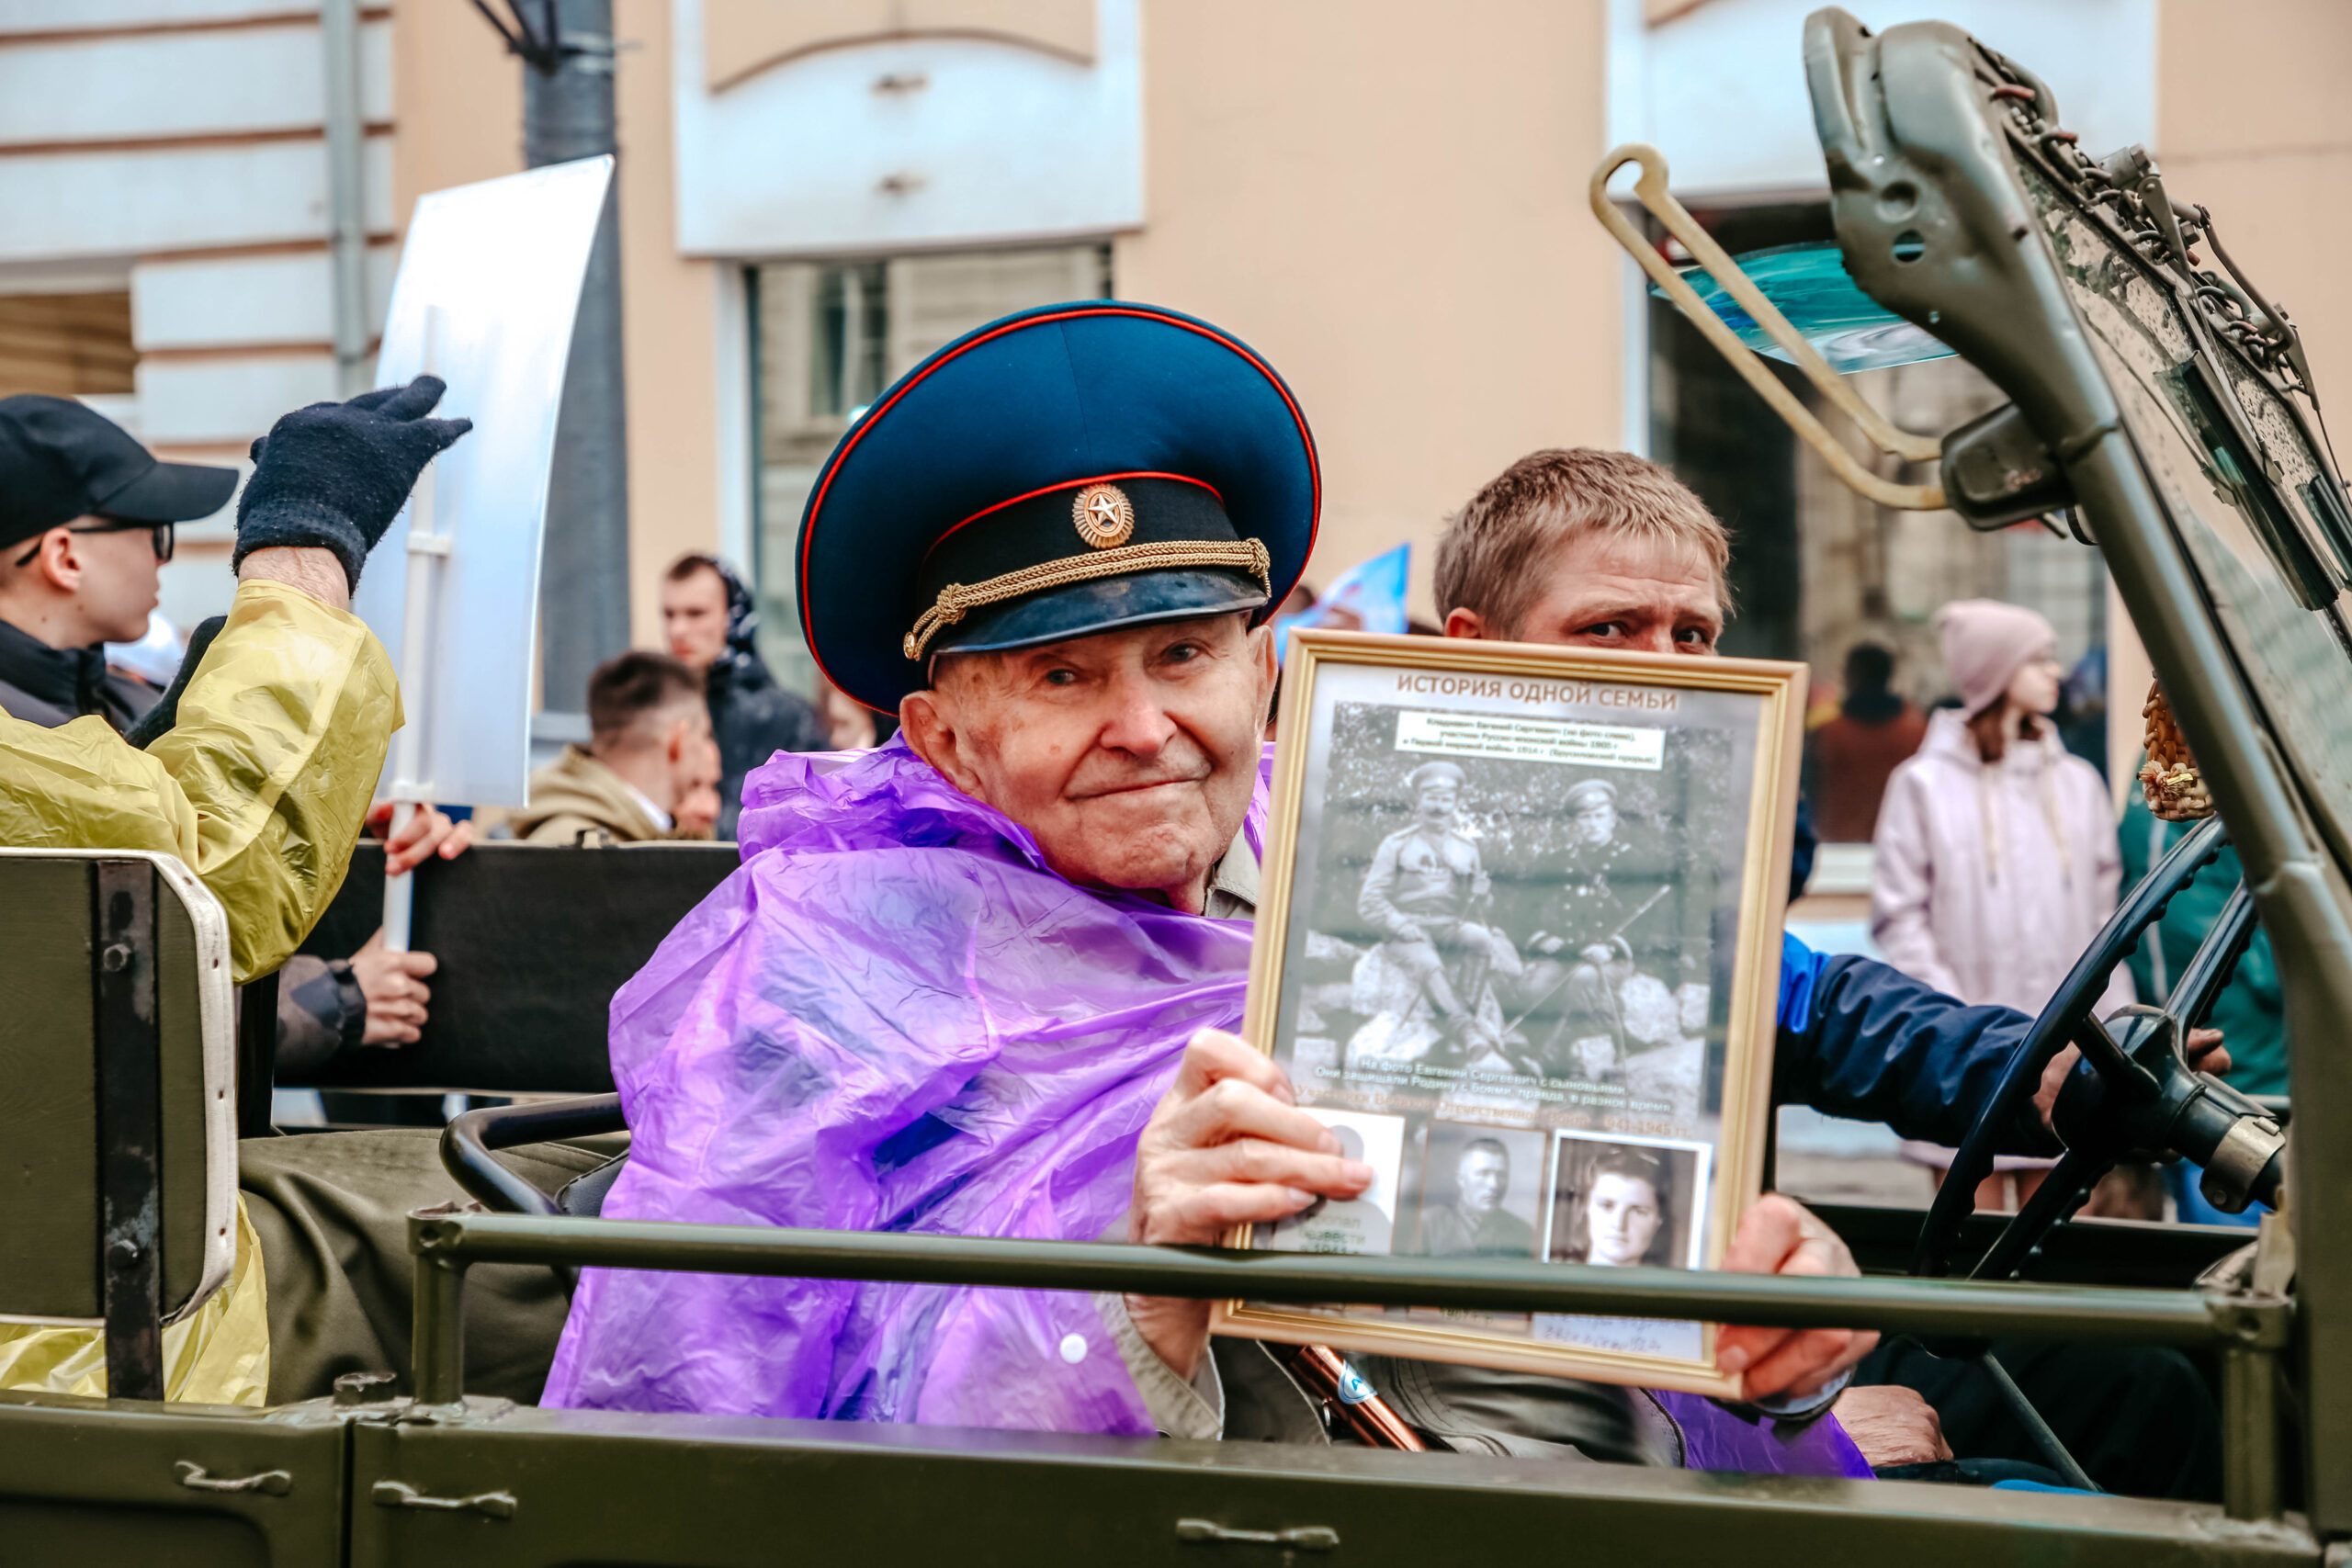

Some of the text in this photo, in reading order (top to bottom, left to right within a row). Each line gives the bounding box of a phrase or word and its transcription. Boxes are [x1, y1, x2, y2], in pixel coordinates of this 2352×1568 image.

[1396, 675, 1678, 711] ИСТОРИЯ ОДНОЙ СЕМЬИ
[1316, 1066, 1341, 1079] Они
[1410, 1075, 1458, 1093] Родину
[1361, 1058, 1377, 1069] На
[1381, 1059, 1413, 1074] фото
[1470, 1068, 1537, 1086] Сергеевич
